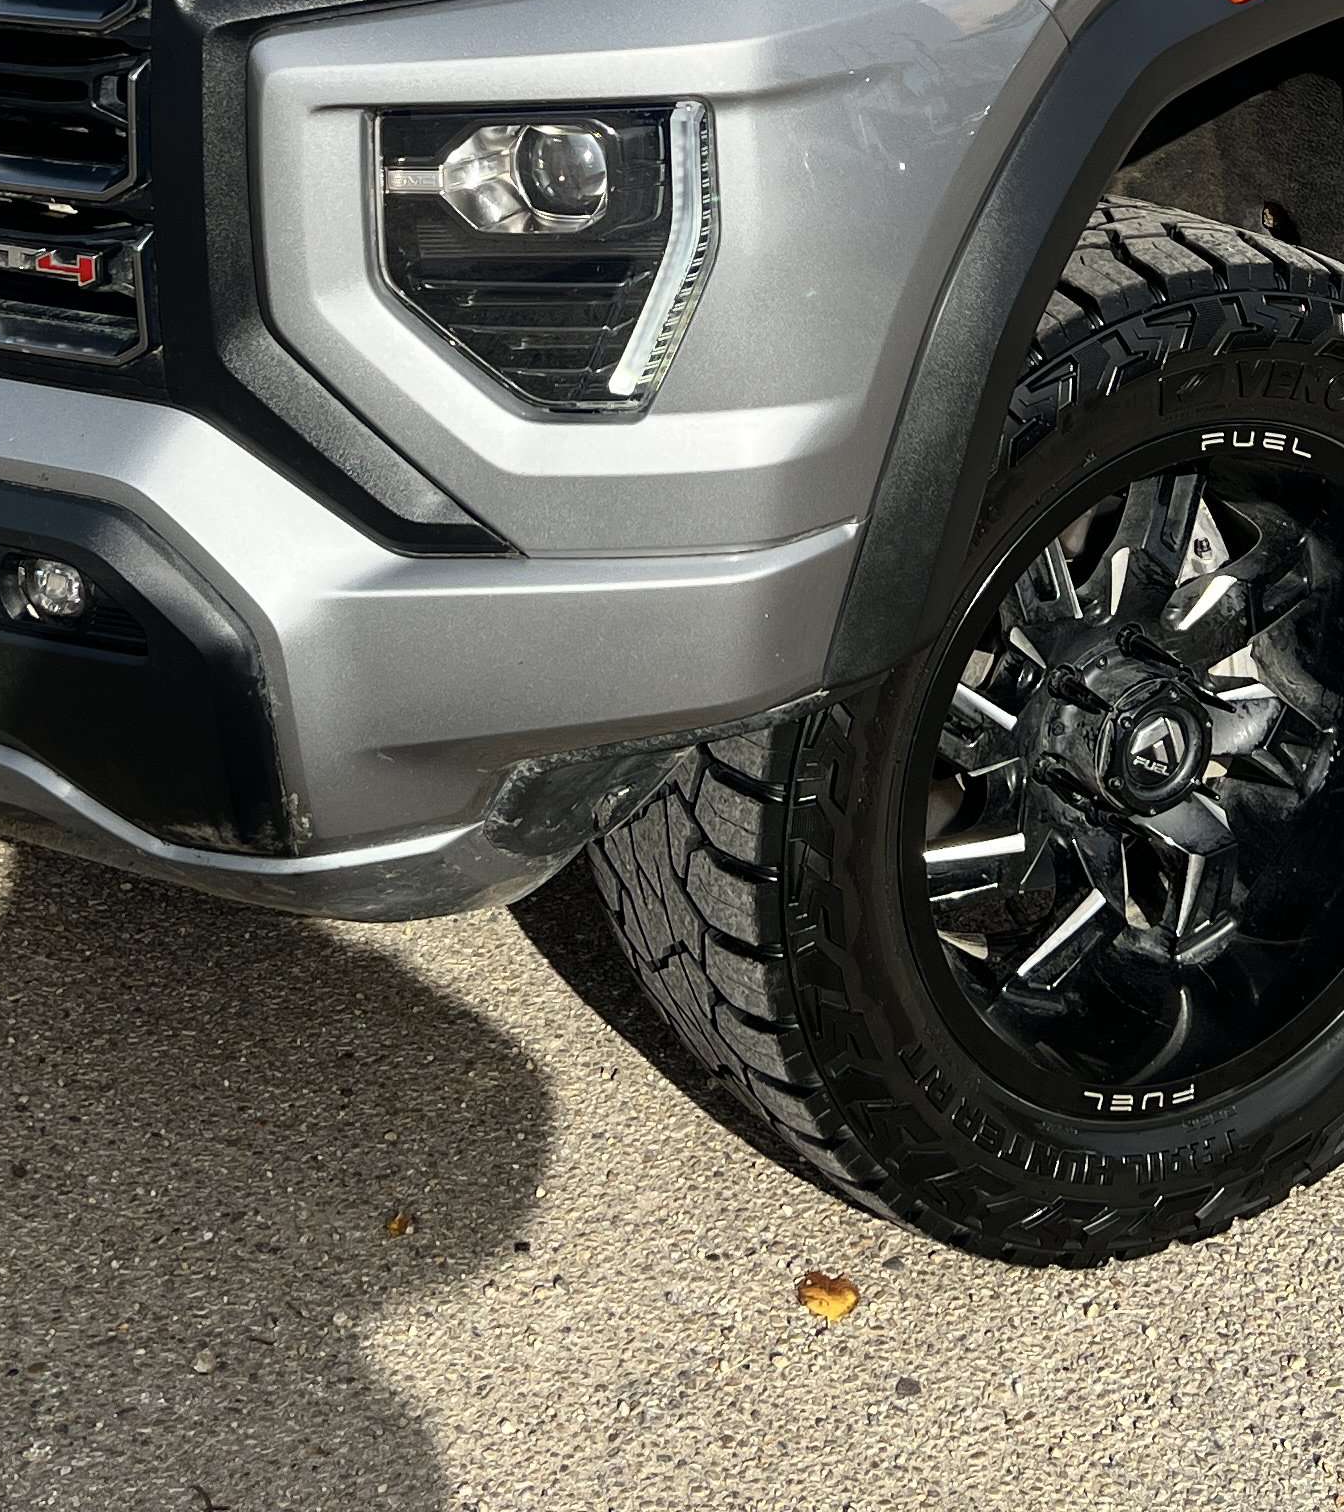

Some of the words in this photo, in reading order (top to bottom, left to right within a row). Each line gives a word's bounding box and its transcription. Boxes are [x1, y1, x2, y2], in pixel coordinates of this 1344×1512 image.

[1202, 431, 1311, 458] FUEL
[1132, 755, 1170, 776] FUEL
[1084, 1084, 1194, 1111] FUEL
[948, 1096, 1114, 1186] HUNTER
[1121, 1128, 1251, 1186] TRAIL
